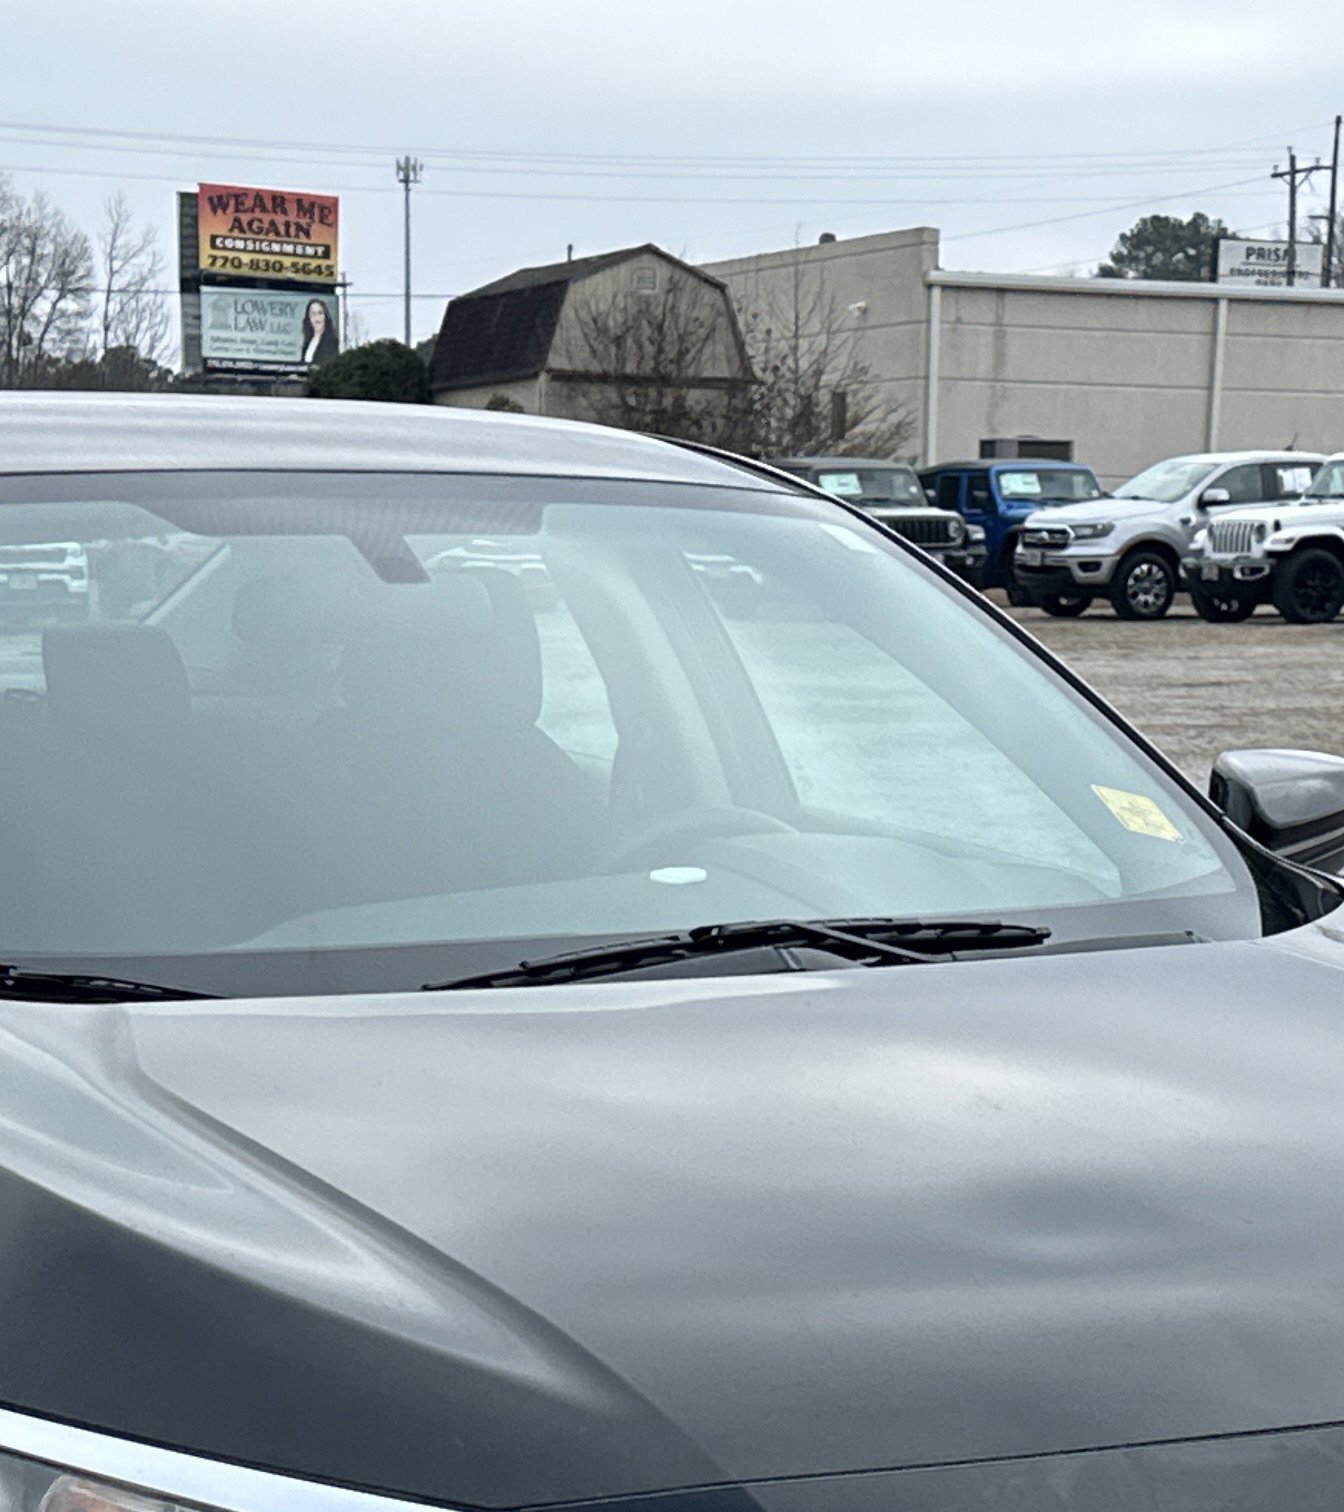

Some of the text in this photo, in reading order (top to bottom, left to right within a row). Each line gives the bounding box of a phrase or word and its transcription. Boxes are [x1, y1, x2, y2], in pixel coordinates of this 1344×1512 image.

[208, 193, 333, 227] WEAR ME
[229, 216, 312, 239] AGAIN
[215, 238, 325, 256] CONSIGNMENT
[208, 255, 334, 277] 770-830-5645
[233, 299, 297, 318] LOWERY
[233, 316, 268, 333] LAW
